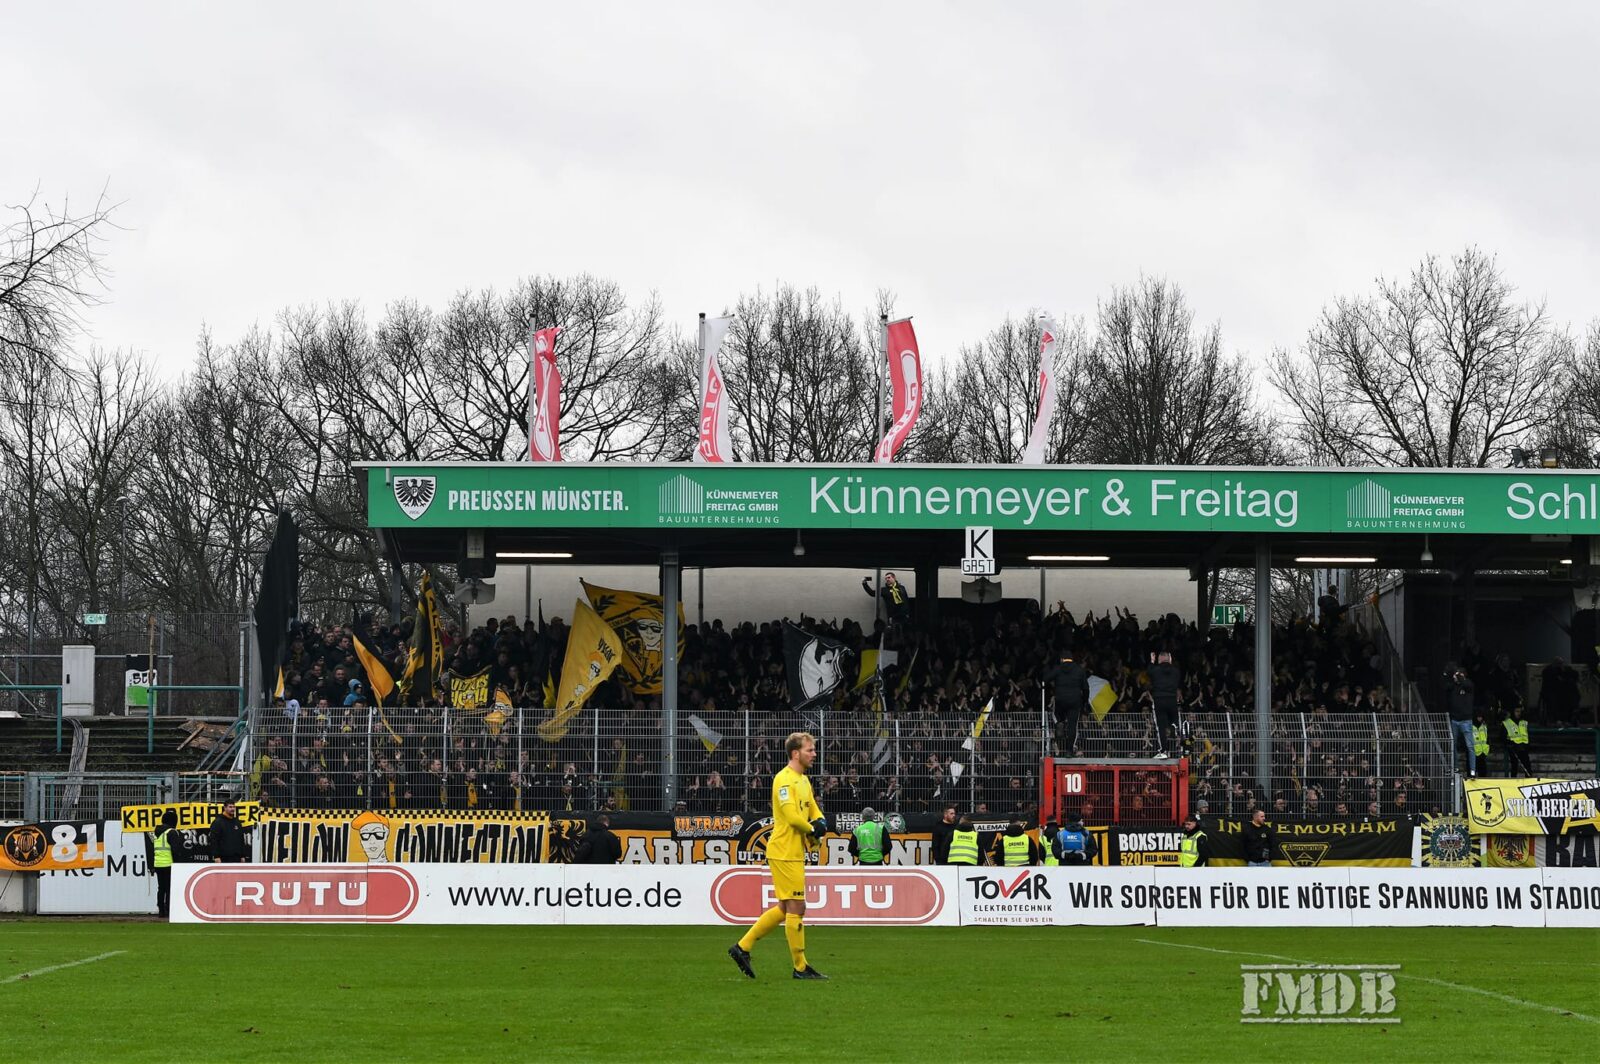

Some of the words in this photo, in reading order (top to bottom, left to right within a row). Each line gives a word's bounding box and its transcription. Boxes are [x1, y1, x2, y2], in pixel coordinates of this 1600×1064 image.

[448, 488, 536, 512] PREUSSEN
[542, 486, 629, 512] MÜNSTER.
[706, 488, 779, 500] KÜNNEMEYER
[810, 476, 1089, 526] Künnemeyer
[1101, 477, 1131, 517] &
[1151, 478, 1299, 527] Freitag
[1393, 493, 1465, 505] KÜNNEMEYER
[1506, 481, 1597, 520] Schl
[706, 502, 746, 512] FREITAG
[748, 502, 779, 512] GMBH
[1393, 508, 1433, 517] FREITAG
[1435, 508, 1465, 517] GMBH
[658, 515, 780, 524] BAUUNTERNEHMUNG
[1347, 520, 1466, 529] BAUUNTERNEHMUNG
[970, 529, 989, 558] K
[962, 559, 993, 573] GAST
[1064, 773, 1082, 793] 10
[123, 804, 259, 829] KAPEHÄER
[1506, 797, 1596, 818] STOLBERGER
[674, 815, 732, 831] ULTRAS
[976, 822, 1008, 831] ALEMAN
[1217, 818, 1242, 834] IN
[1264, 820, 1397, 837] EMORIAM
[51, 823, 103, 863] 81
[395, 822, 544, 864] CONNECTION
[615, 837, 730, 864] ARLS
[1118, 832, 1183, 852] BOXSTAF
[1120, 852, 1142, 866] 520
[235, 881, 367, 906] RÜTÜ
[448, 881, 682, 908] www.ruetue.de
[965, 869, 1052, 900] TOVAR
[1069, 882, 1113, 908] WIR
[1121, 885, 1202, 909] SORGEN
[1210, 882, 1250, 909] FÜR
[1257, 886, 1290, 909] DIE
[1297, 882, 1371, 909] NÖTIGE
[1378, 882, 1488, 910] SPANNUNG
[1496, 886, 1522, 910] IM
[973, 904, 1053, 912] ELEKTROTECHNIK
